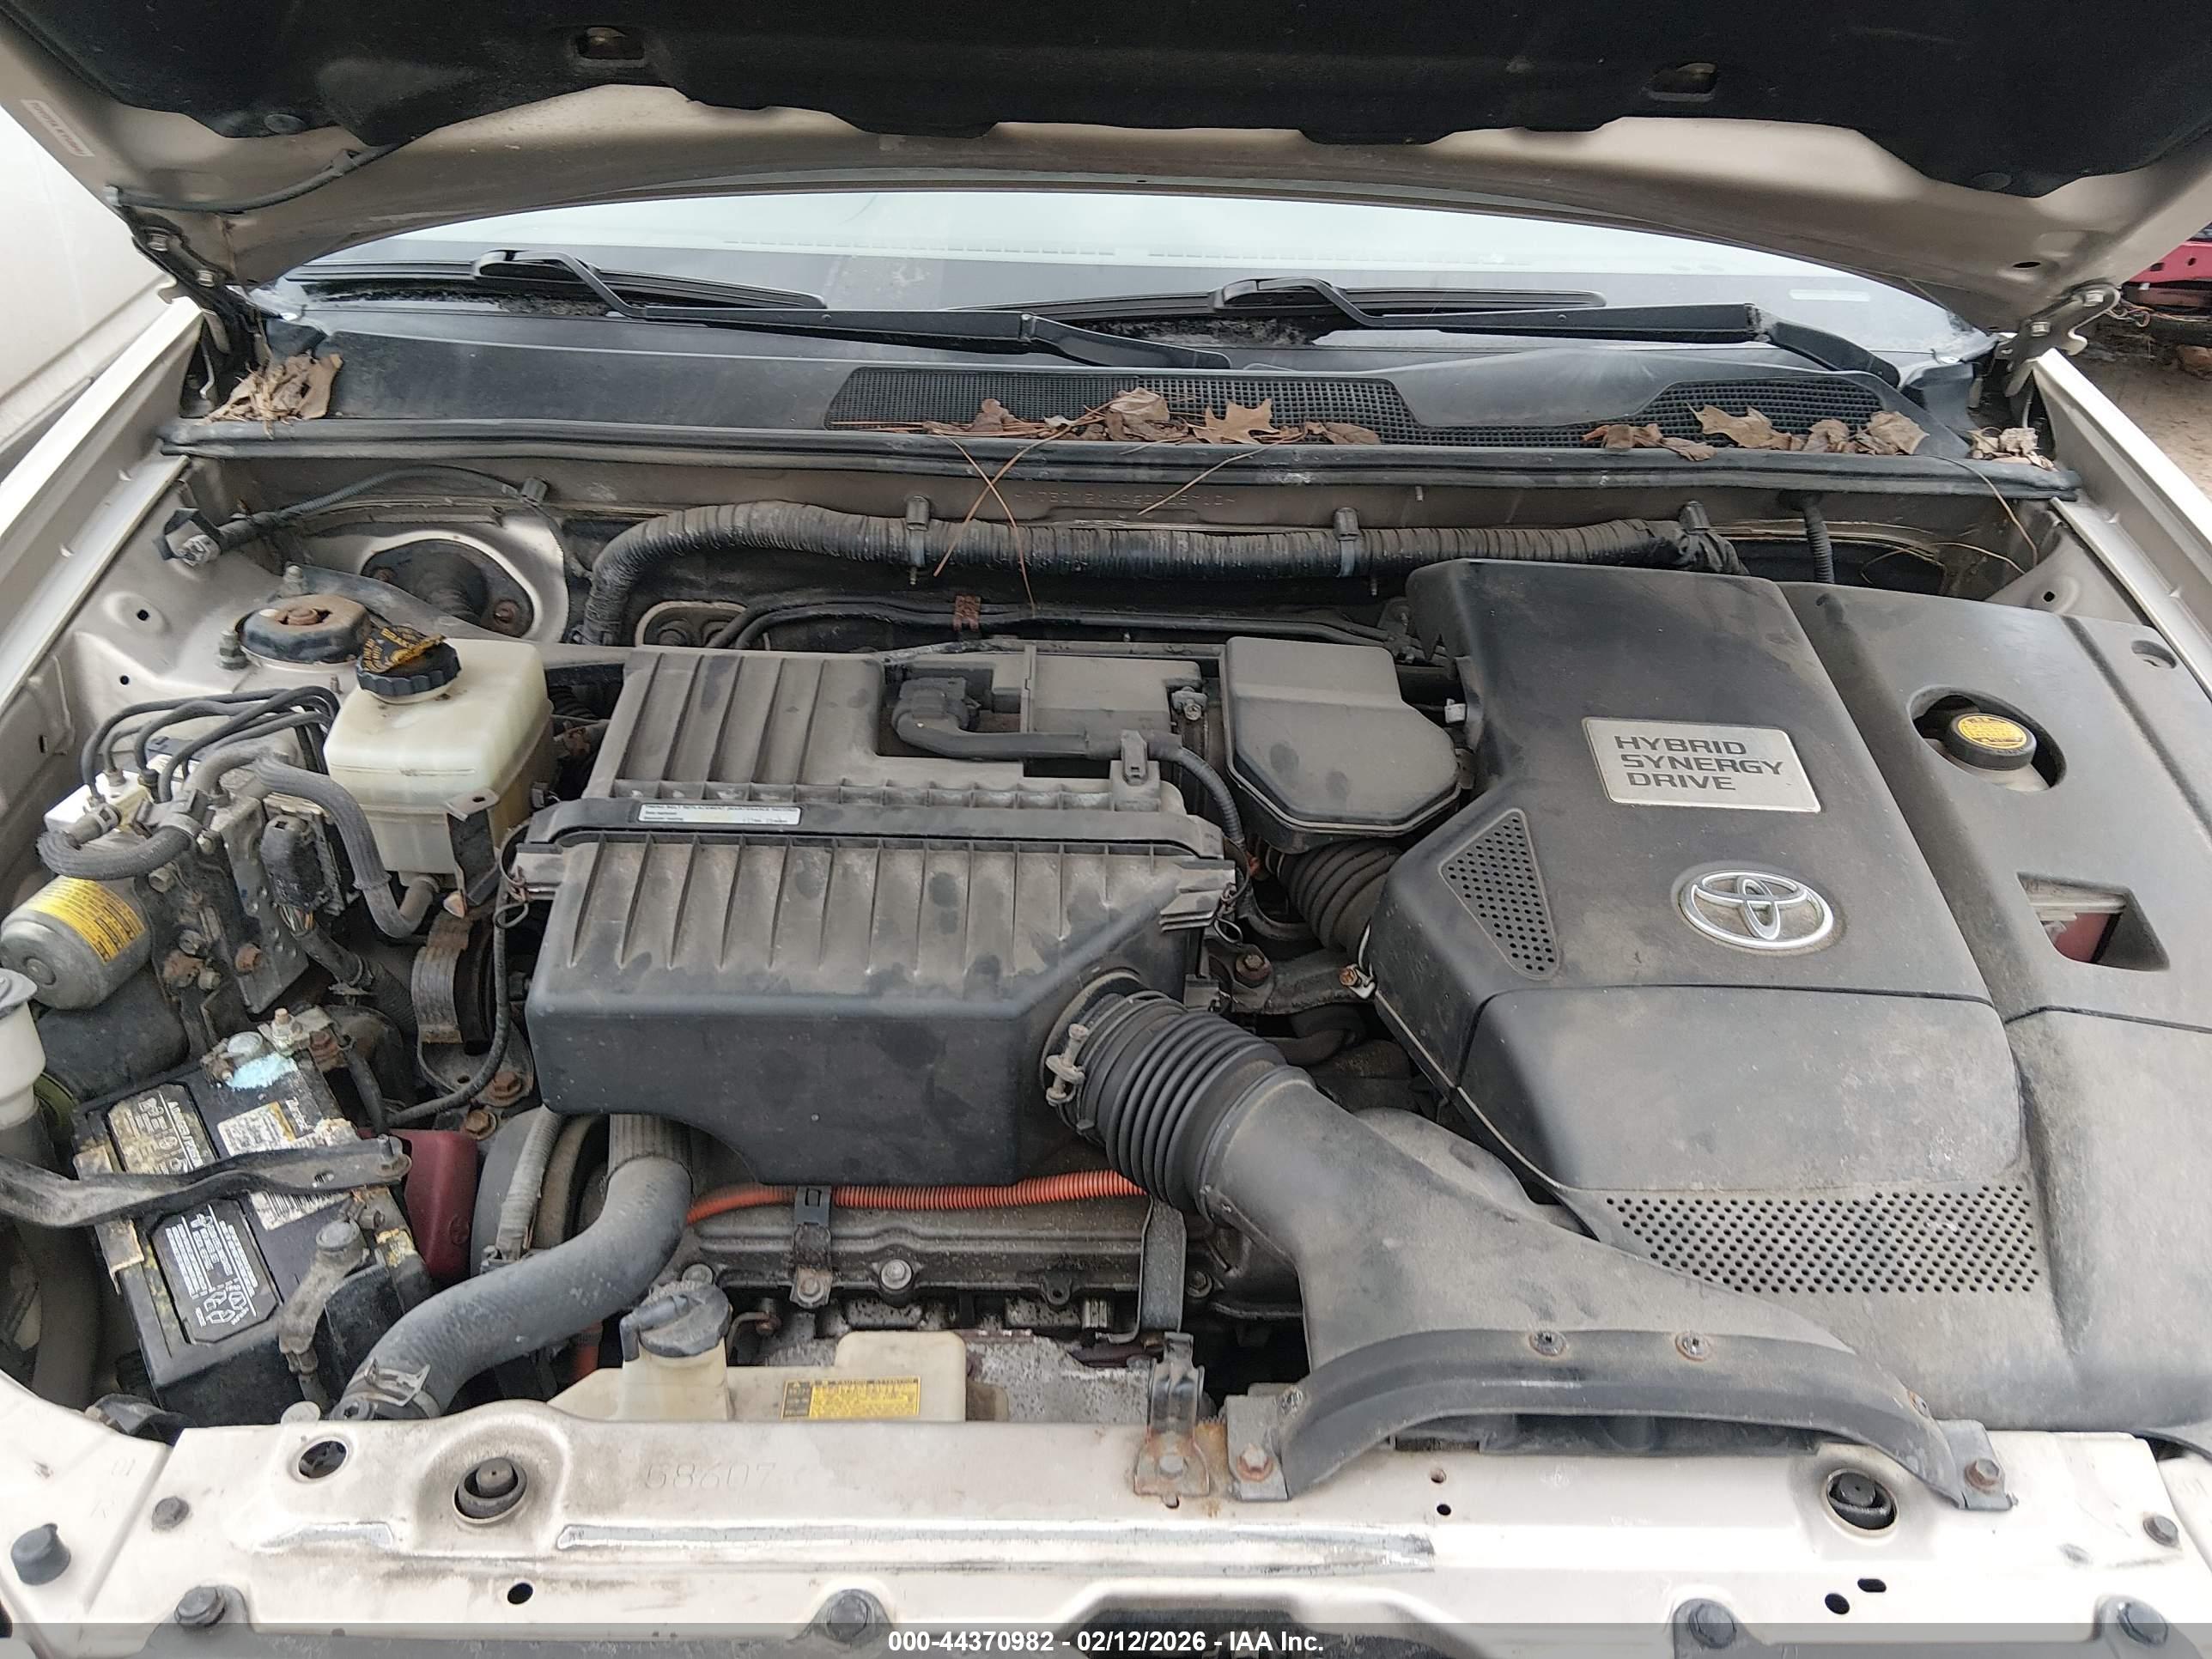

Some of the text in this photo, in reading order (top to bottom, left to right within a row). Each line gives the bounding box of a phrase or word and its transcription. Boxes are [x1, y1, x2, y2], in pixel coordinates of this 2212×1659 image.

[1613, 735, 1747, 756] HYBRID
[1620, 753, 1784, 775] SYNERGY
[1626, 772, 1736, 791] DRIVE
